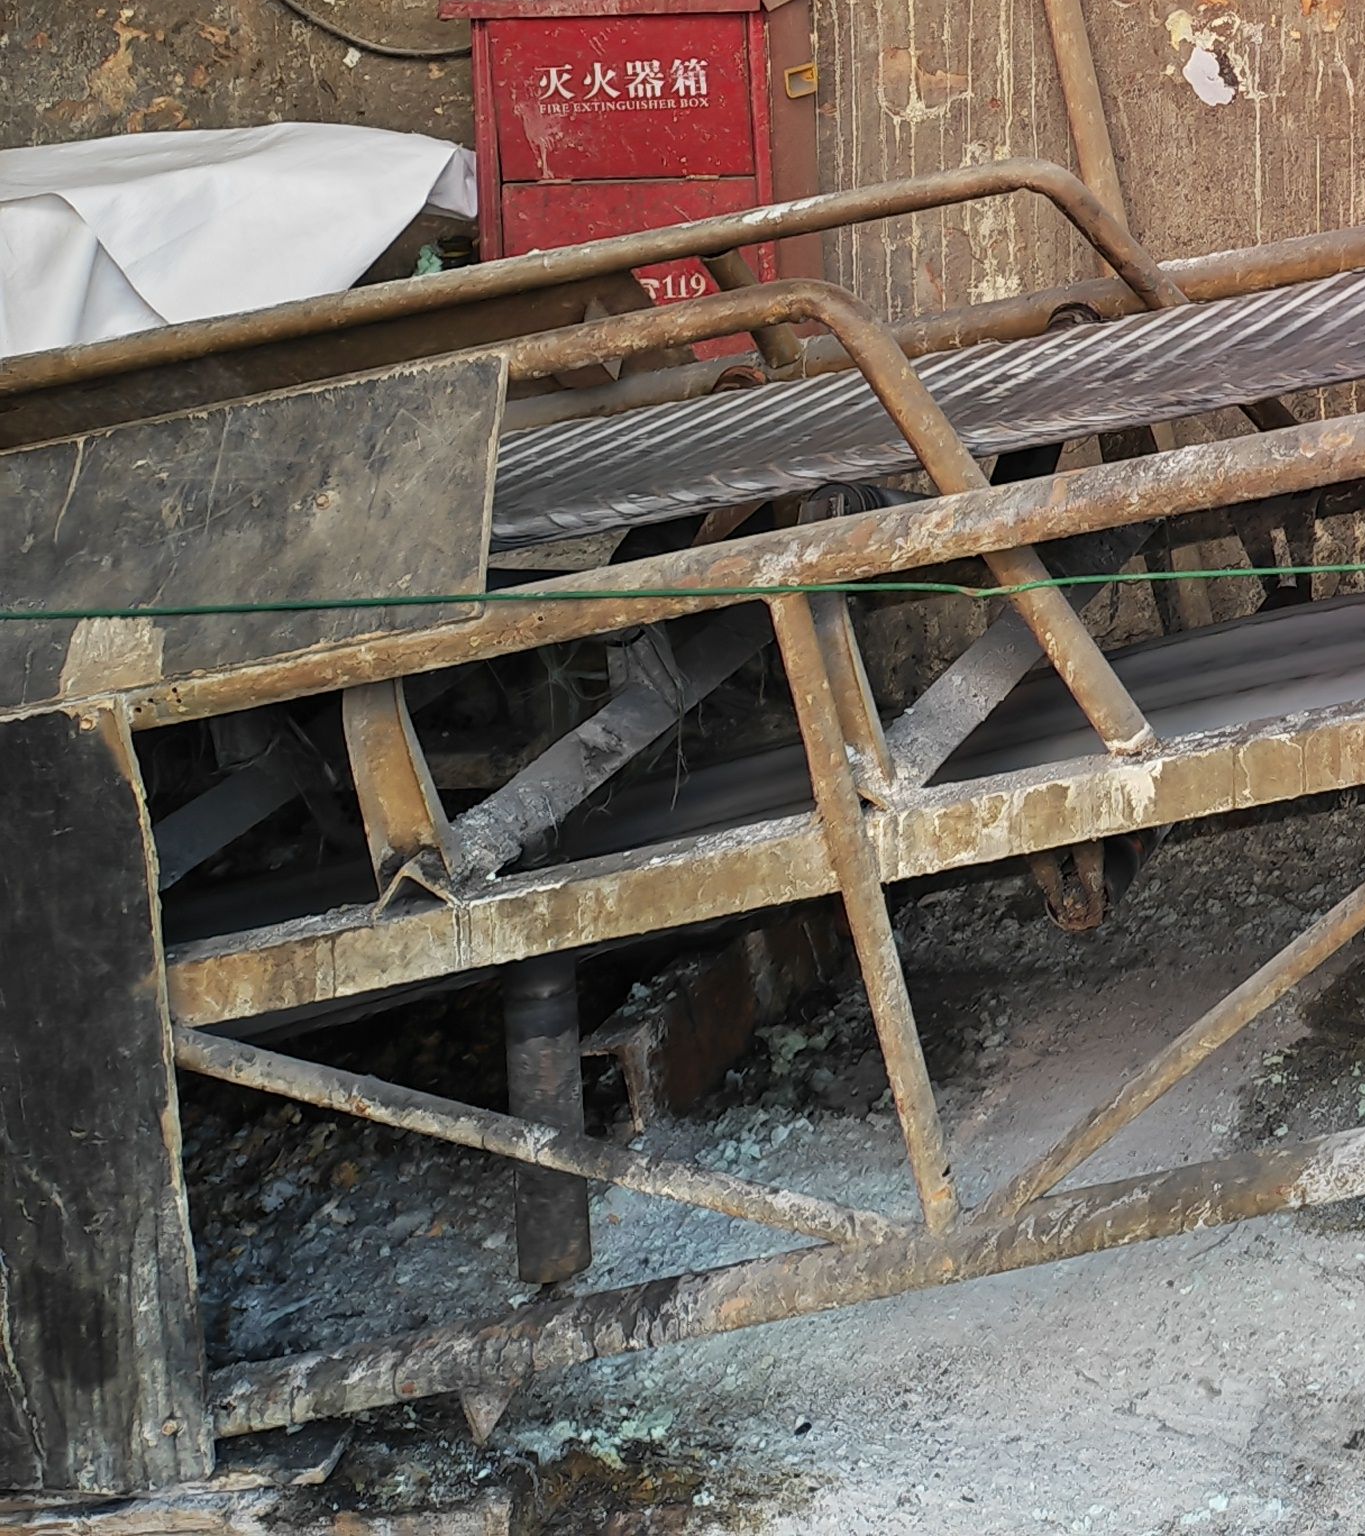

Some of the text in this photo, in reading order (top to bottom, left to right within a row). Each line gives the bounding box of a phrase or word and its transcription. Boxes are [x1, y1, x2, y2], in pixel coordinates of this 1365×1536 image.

[535, 59, 708, 100] 灭火器箱
[540, 97, 709, 114] FIRE EXTINGUISHER BOX
[663, 273, 706, 299] 119
